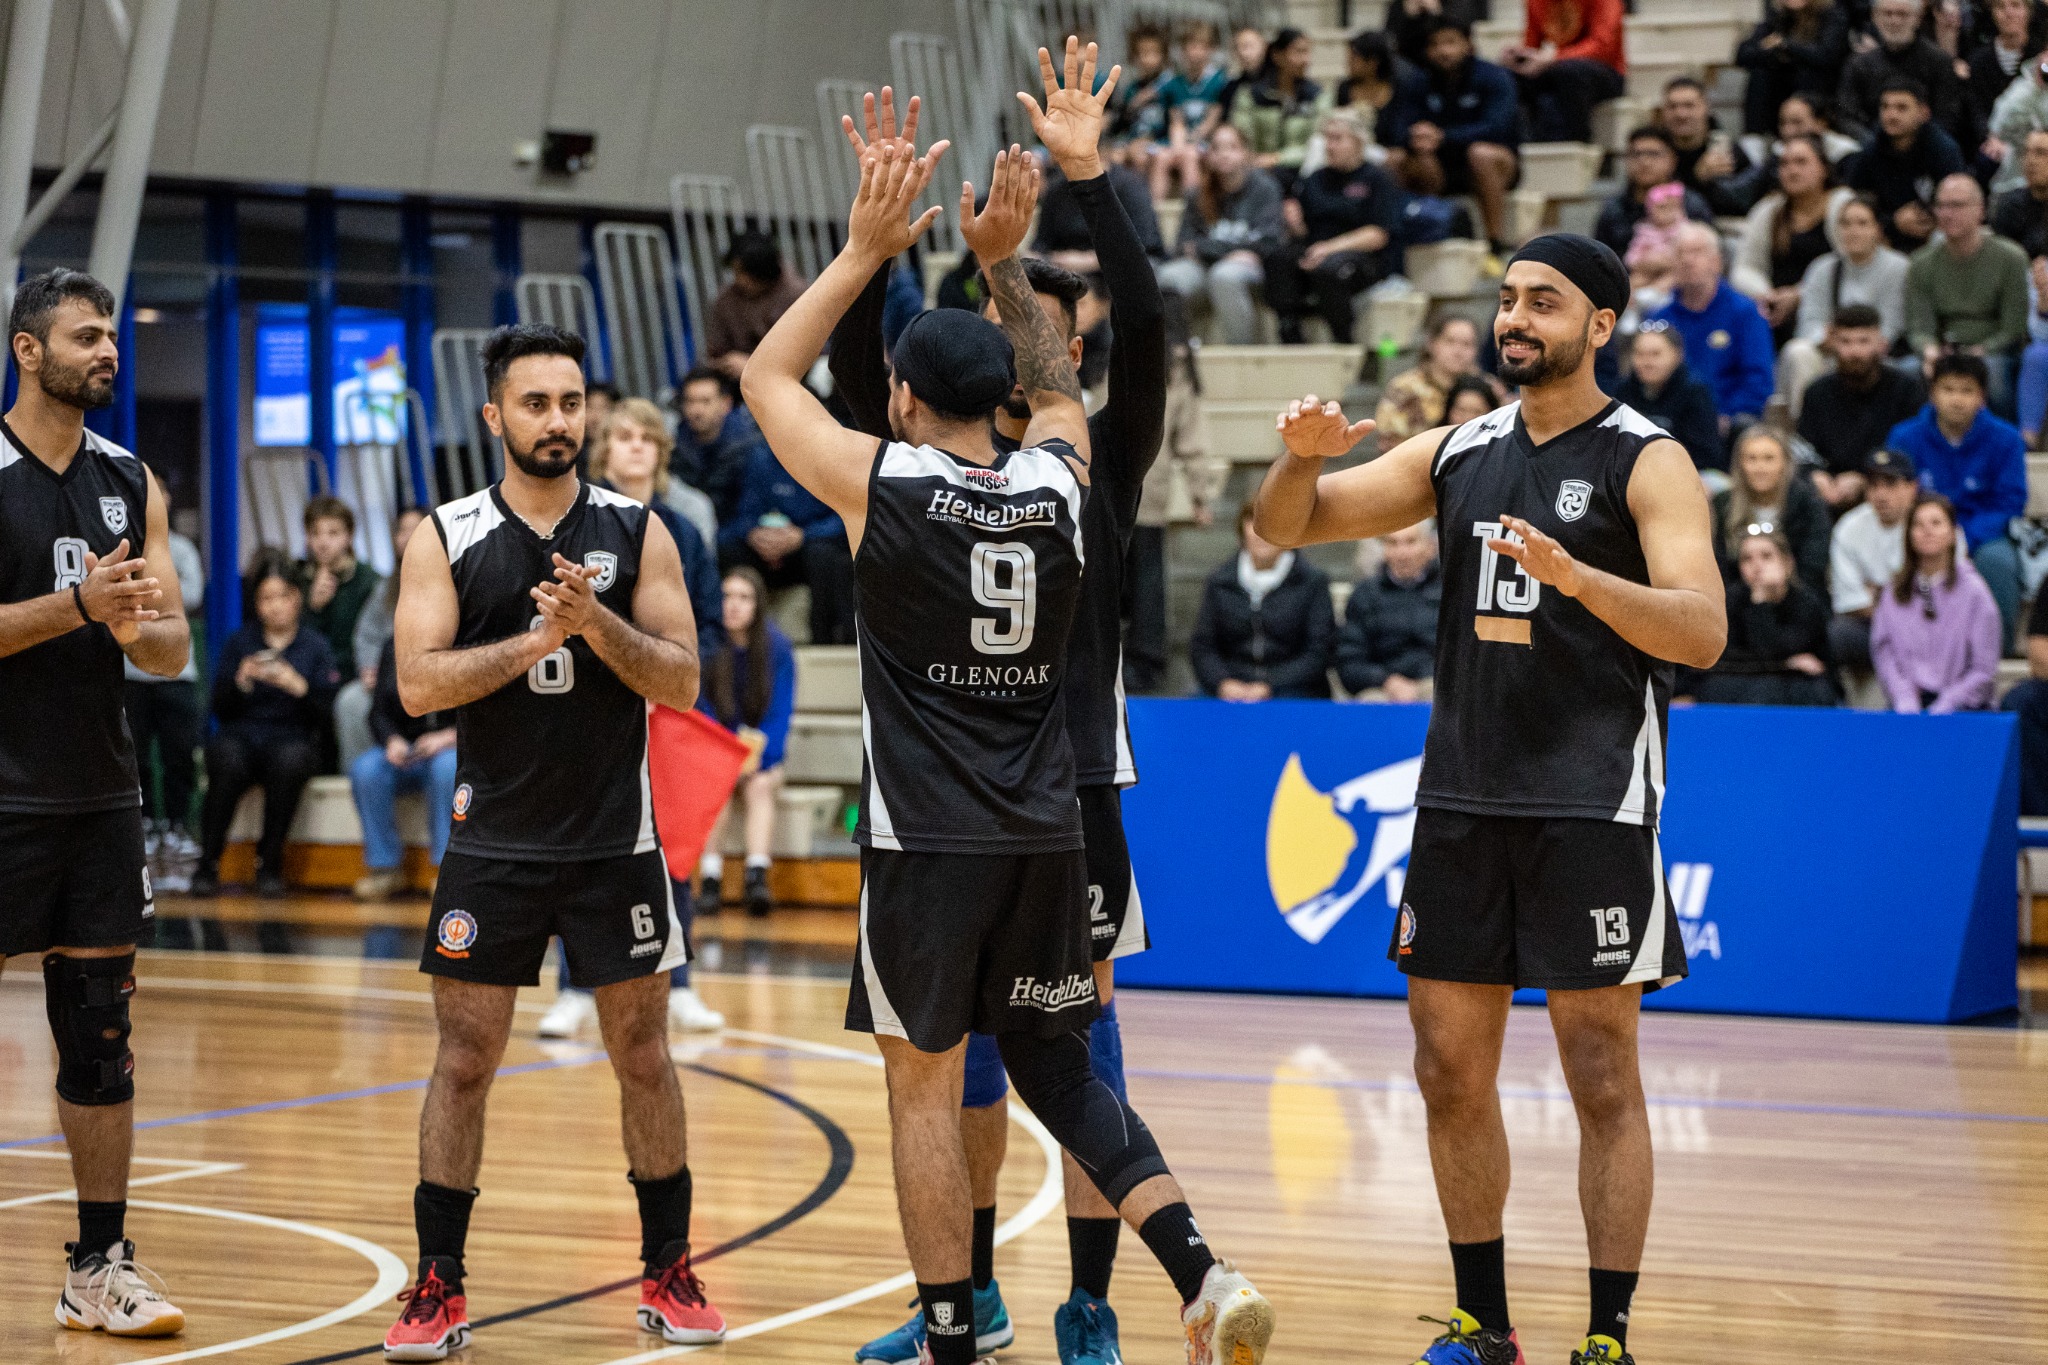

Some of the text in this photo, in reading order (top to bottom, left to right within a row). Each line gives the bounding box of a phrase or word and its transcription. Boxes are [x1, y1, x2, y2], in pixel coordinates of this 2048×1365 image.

[926, 513, 967, 525] VOLLEYBALL
[927, 489, 1057, 526] Heidelberg
[53, 536, 90, 593] 8
[1472, 521, 1541, 613] 13
[970, 541, 1037, 655] 9
[927, 663, 1050, 685] GLENOAK
[630, 903, 655, 940] 6
[1088, 884, 1108, 922] 2
[1589, 906, 1631, 947] 13
[1008, 1000, 1044, 1011] VOLLEYBALL
[1009, 974, 1095, 1006] Heidelber
